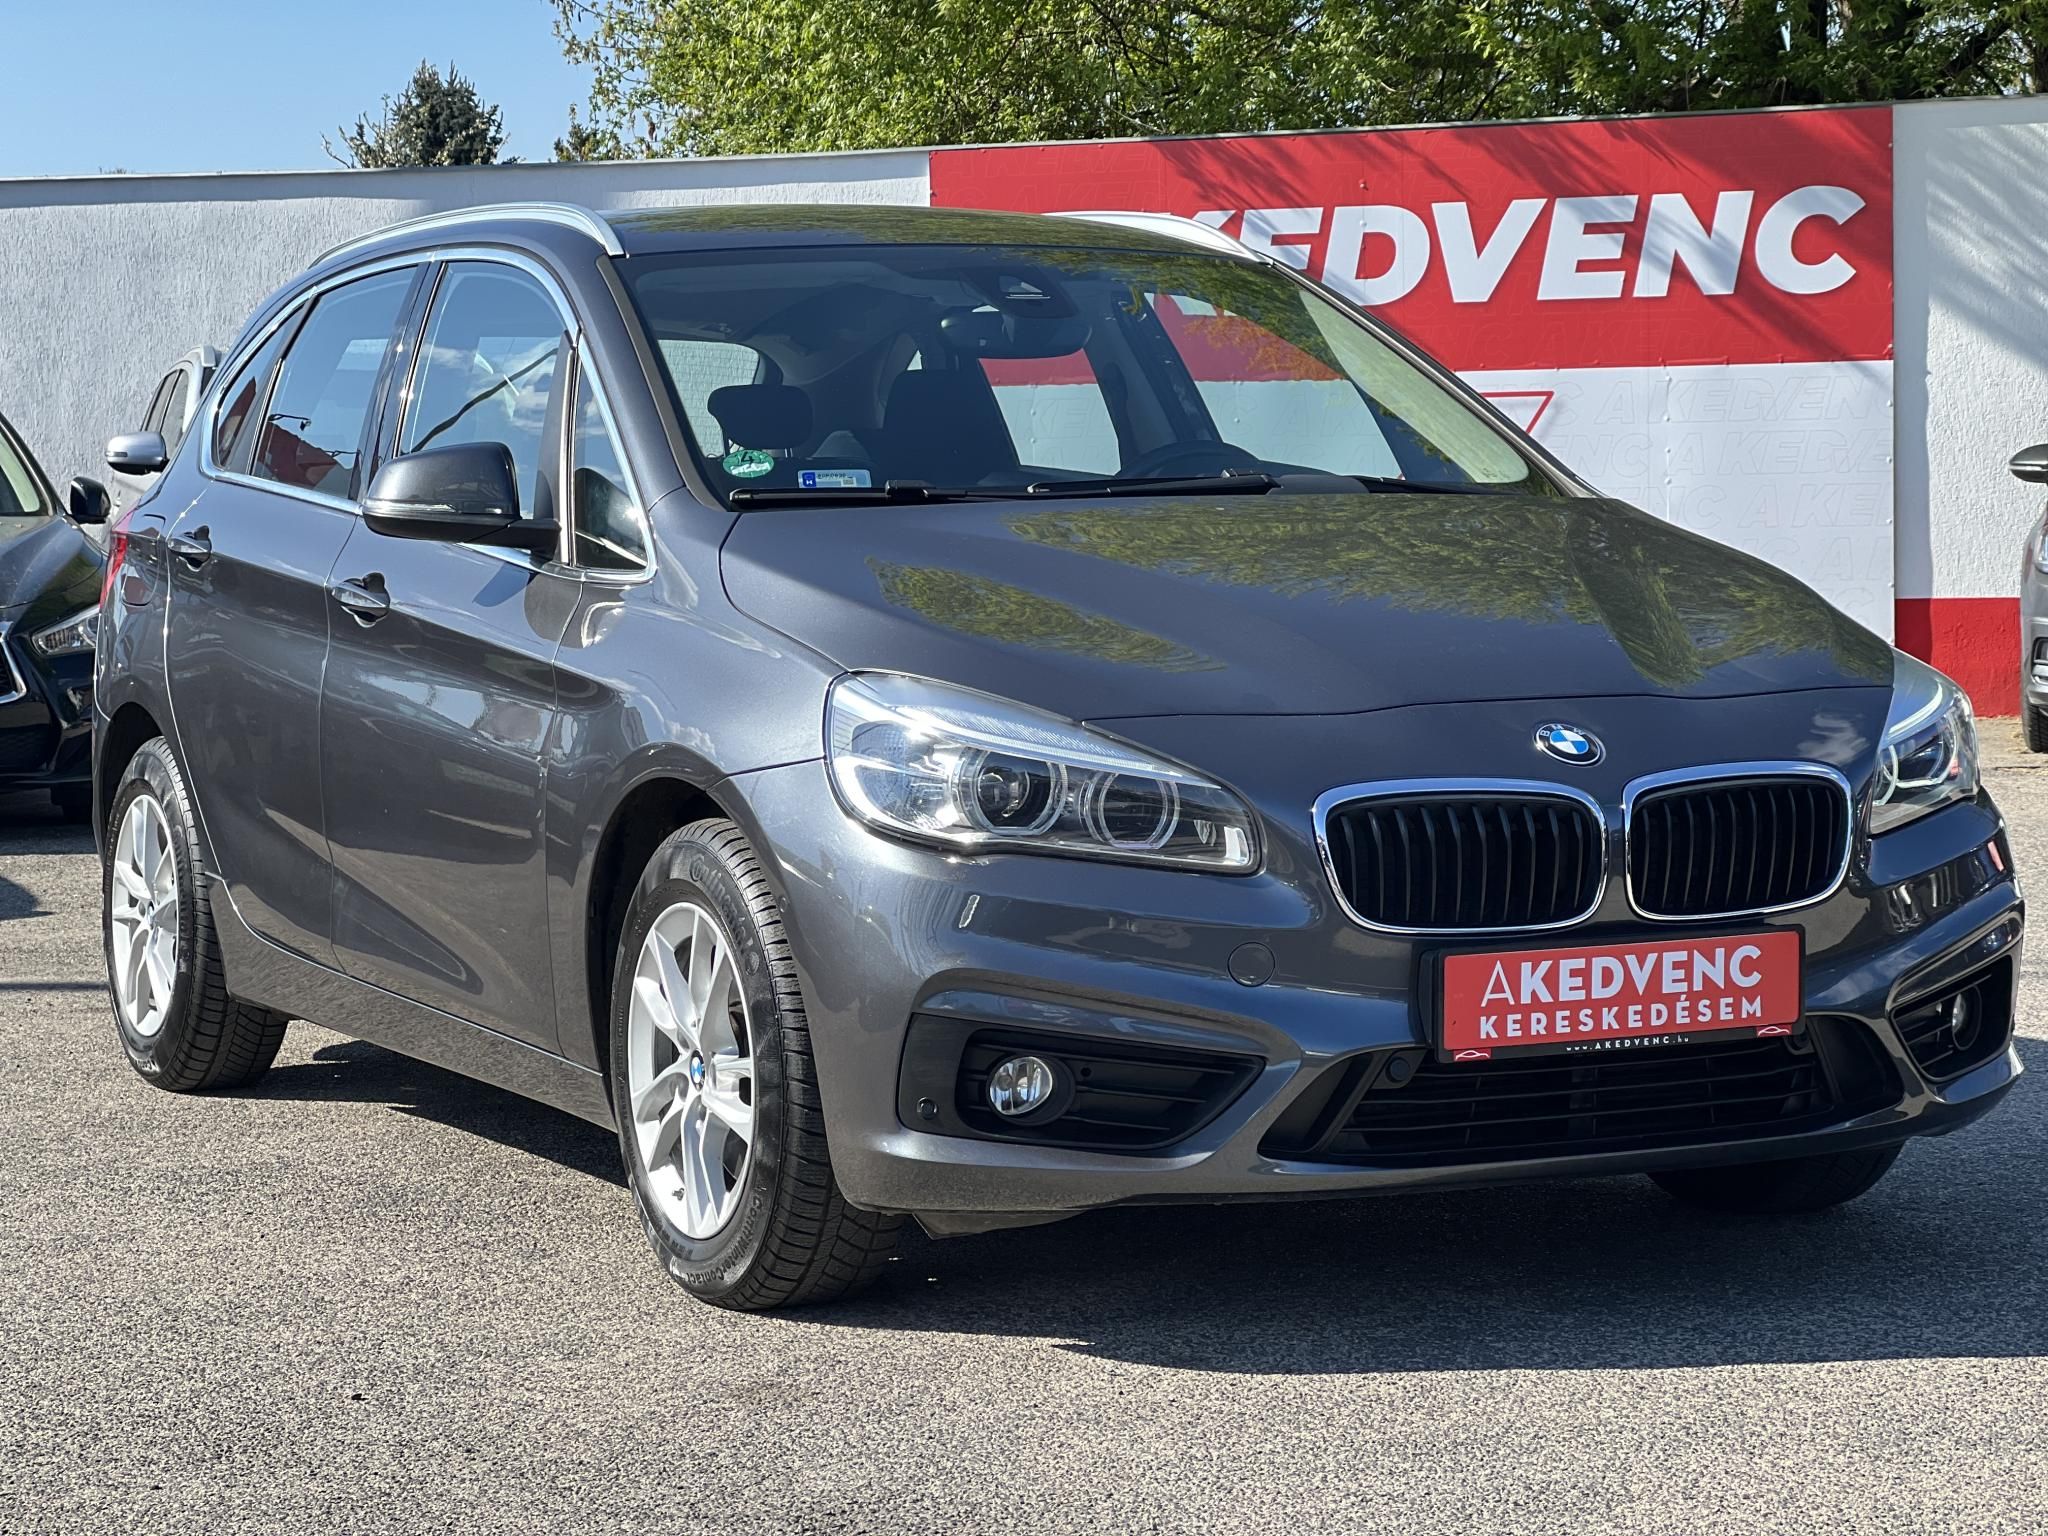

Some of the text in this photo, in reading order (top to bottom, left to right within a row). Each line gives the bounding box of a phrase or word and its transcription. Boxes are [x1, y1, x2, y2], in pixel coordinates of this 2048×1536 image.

[1192, 186, 1867, 306] EDVENC
[1481, 945, 1762, 1007] AKEDVENC
[1480, 995, 1762, 1039] KERESKEDÉSEM
[1566, 1035, 1689, 1051] www.AKEDVENC.hu
